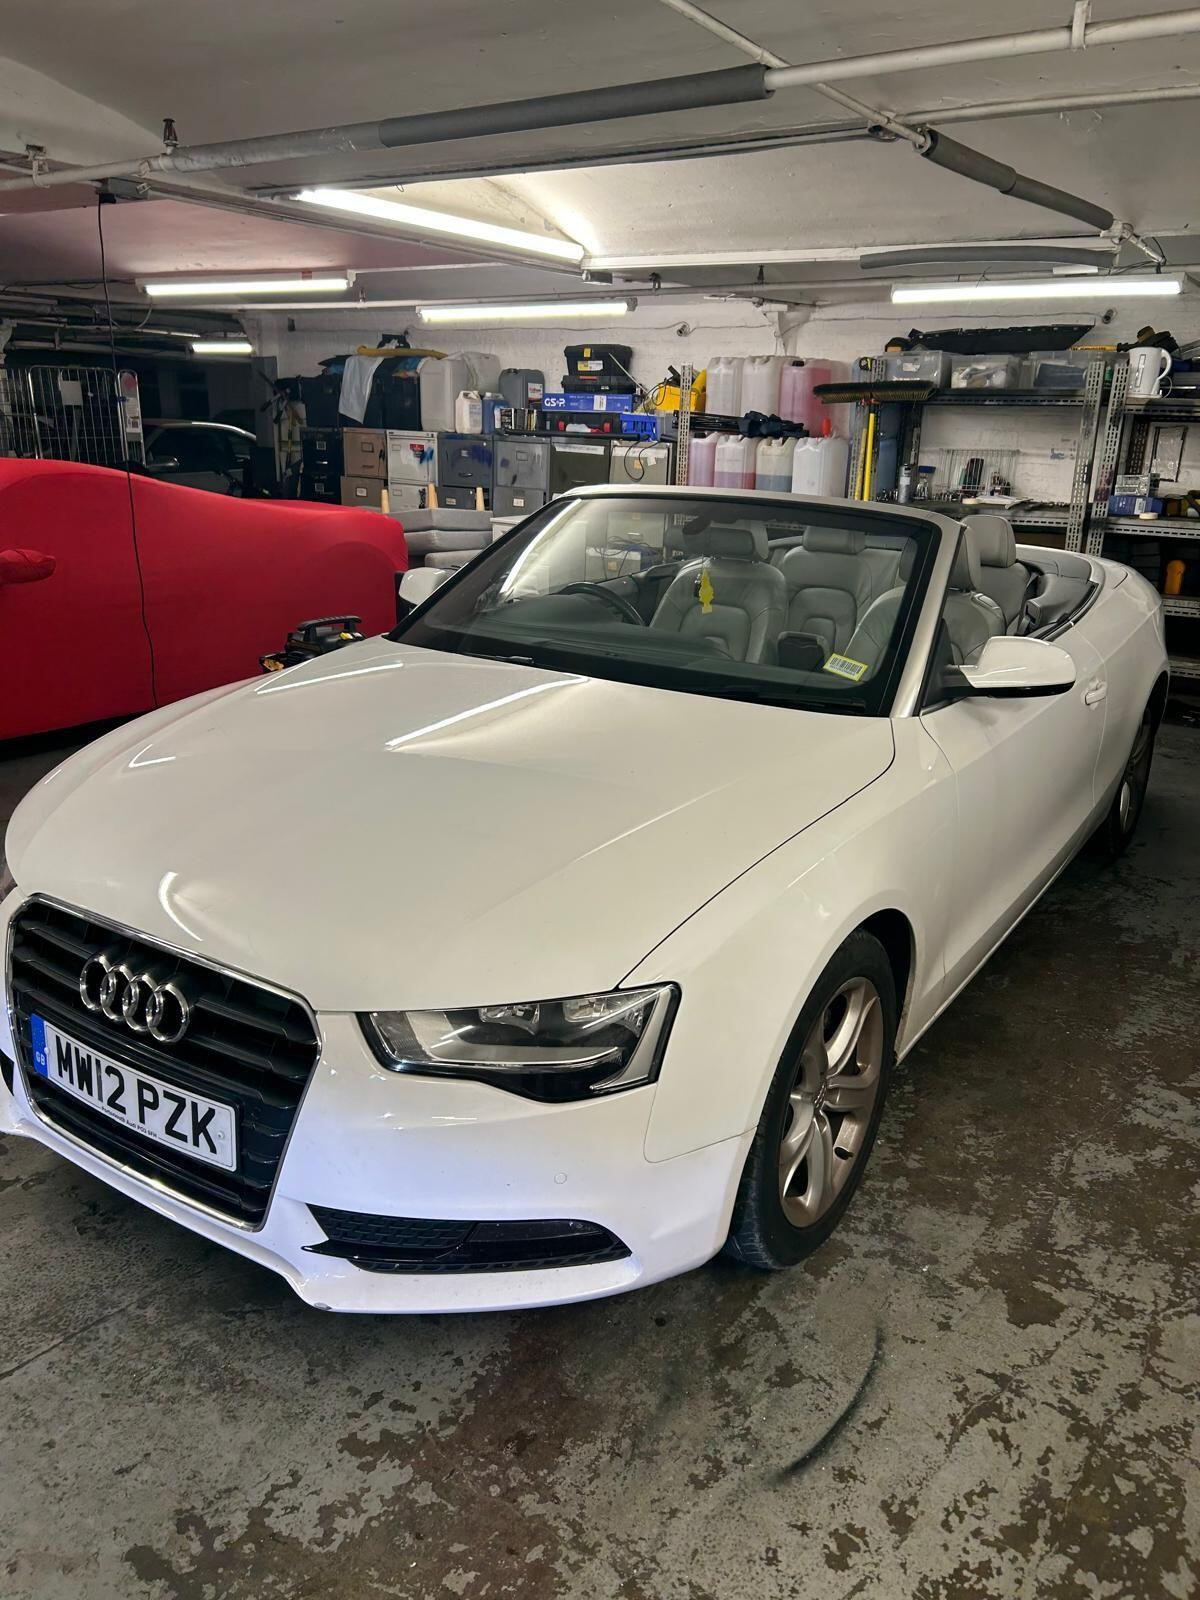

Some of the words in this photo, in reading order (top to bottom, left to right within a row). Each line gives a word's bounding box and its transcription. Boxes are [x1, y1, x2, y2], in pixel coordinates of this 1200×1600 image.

[35, 1051, 46, 1066] GB
[55, 1034, 127, 1115] MW12
[136, 1078, 218, 1155] PZK
